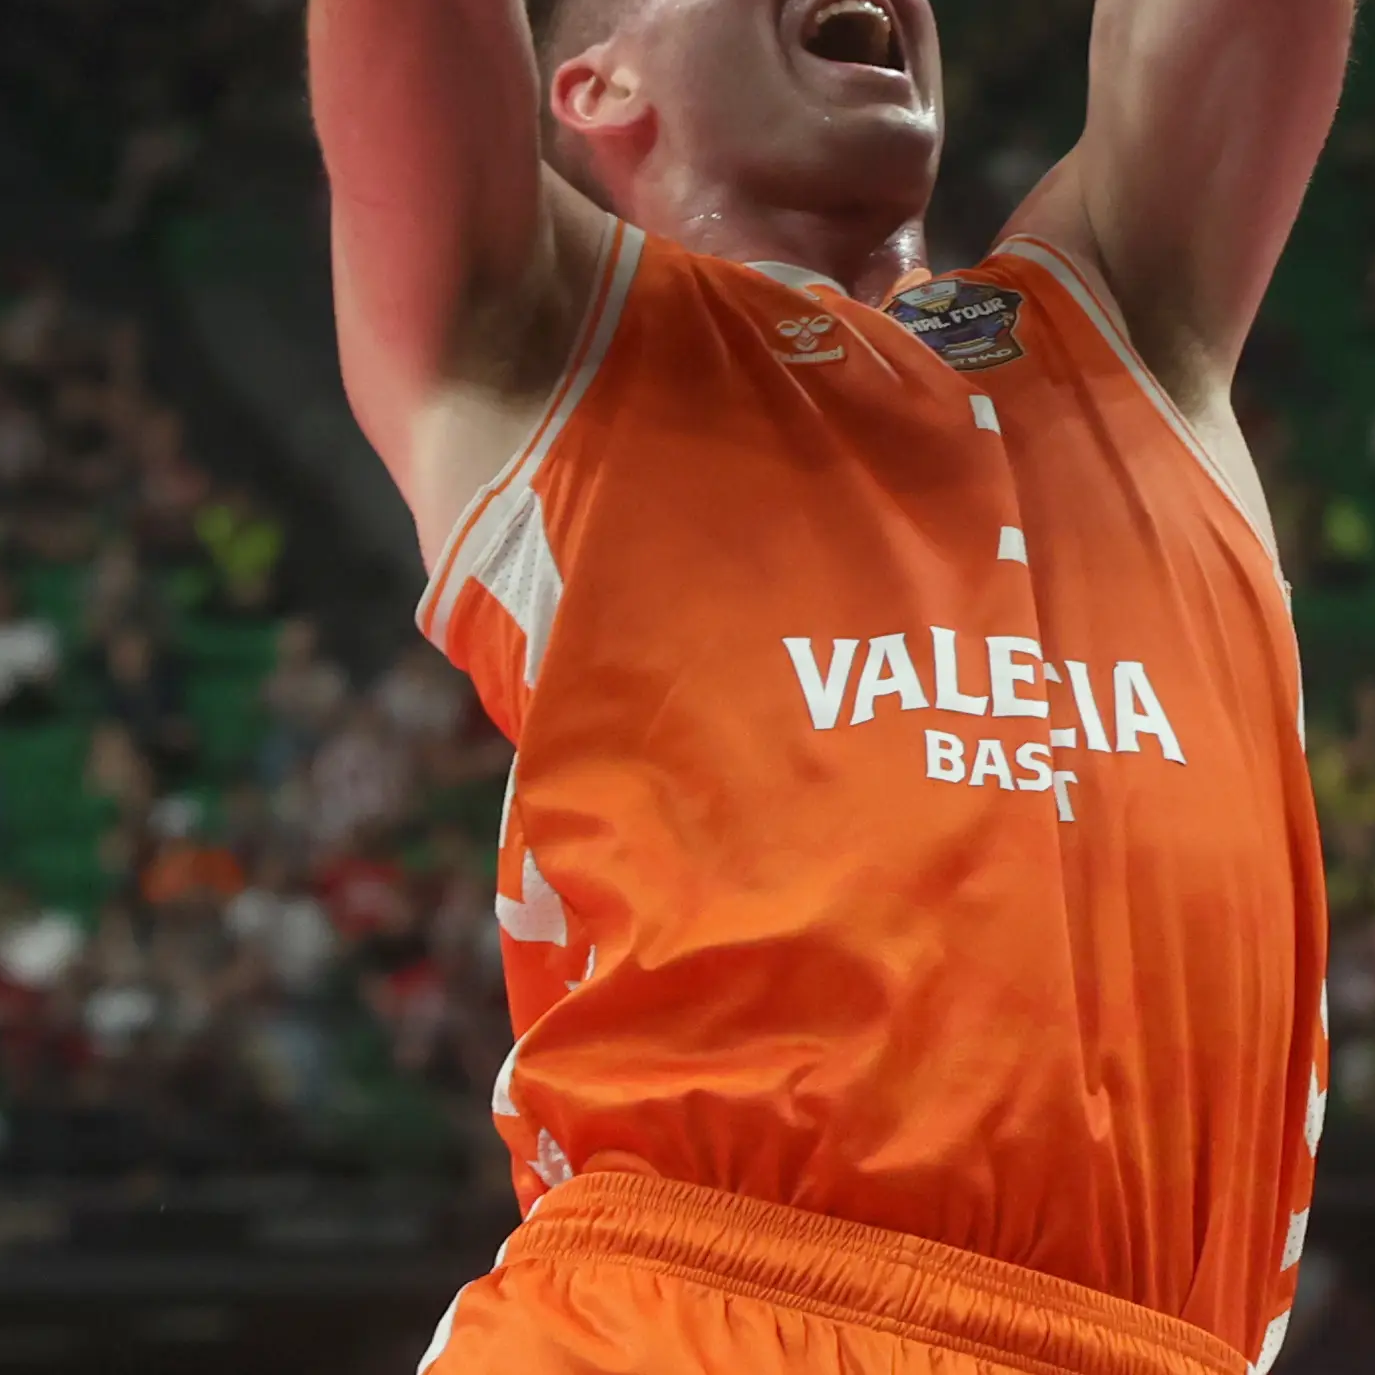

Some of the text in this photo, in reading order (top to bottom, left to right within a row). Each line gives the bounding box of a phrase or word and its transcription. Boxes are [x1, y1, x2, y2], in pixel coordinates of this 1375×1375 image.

[949, 296, 1007, 324] FOUR
[782, 625, 1187, 766] VALEIA
[924, 729, 1079, 822] BAST
